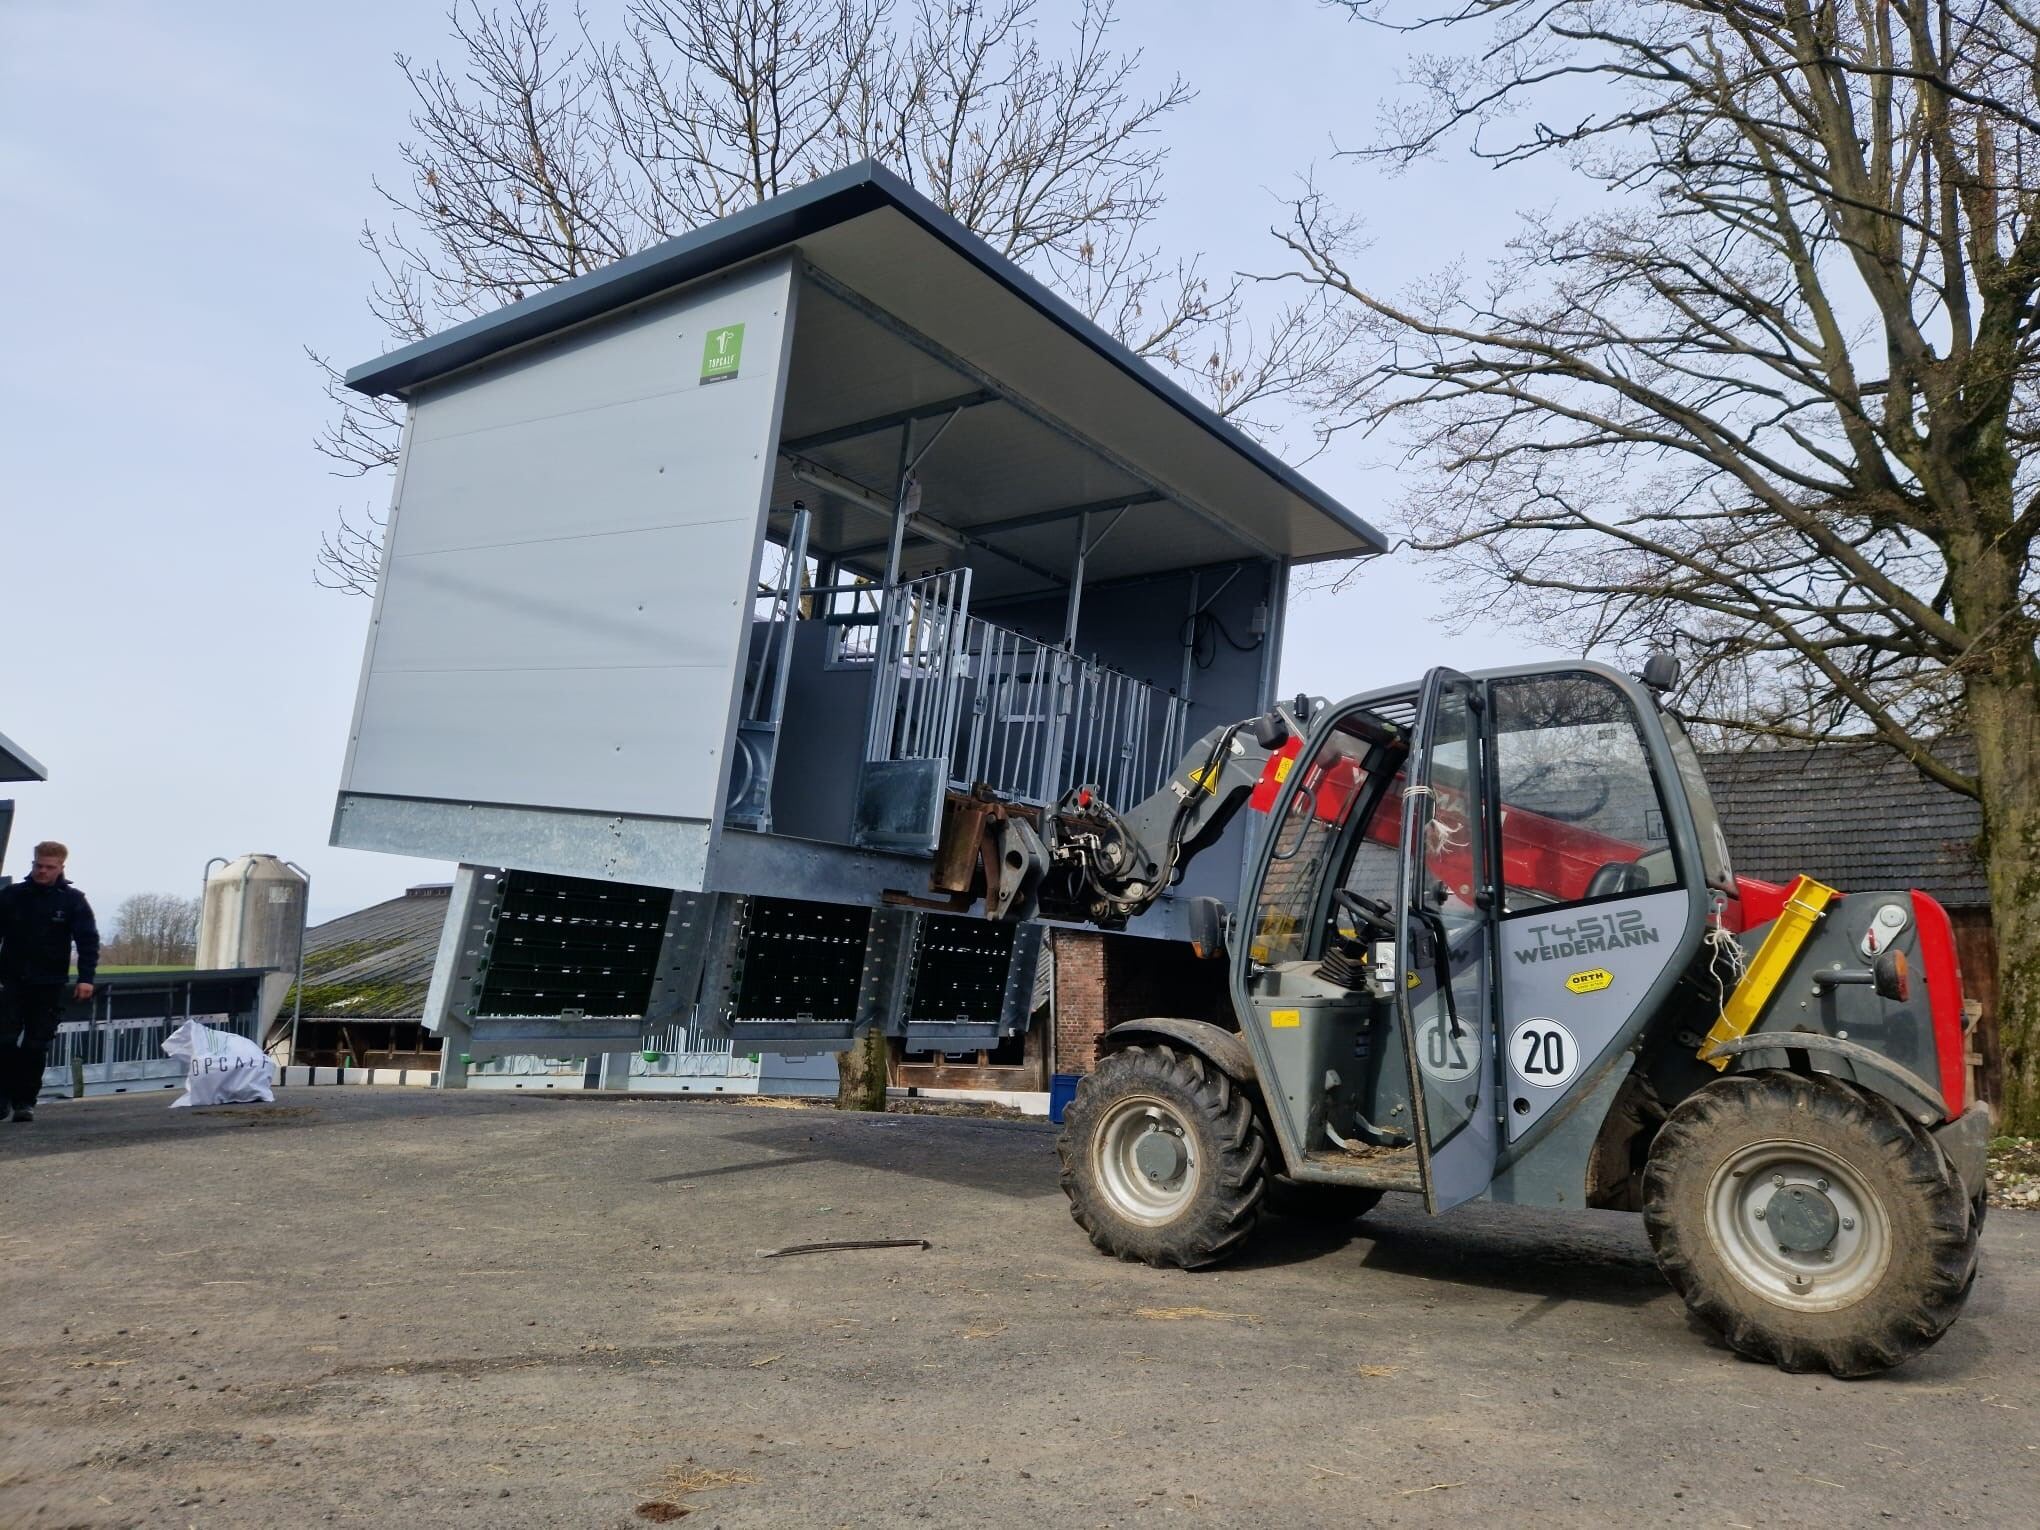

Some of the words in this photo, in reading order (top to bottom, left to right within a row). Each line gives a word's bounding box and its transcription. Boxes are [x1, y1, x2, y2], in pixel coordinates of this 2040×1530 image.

[1528, 909, 1646, 946] T4512
[1514, 928, 1660, 965] WEIDEMANN
[1572, 972, 1604, 984] ORTH
[1522, 1030, 1564, 1075] 20
